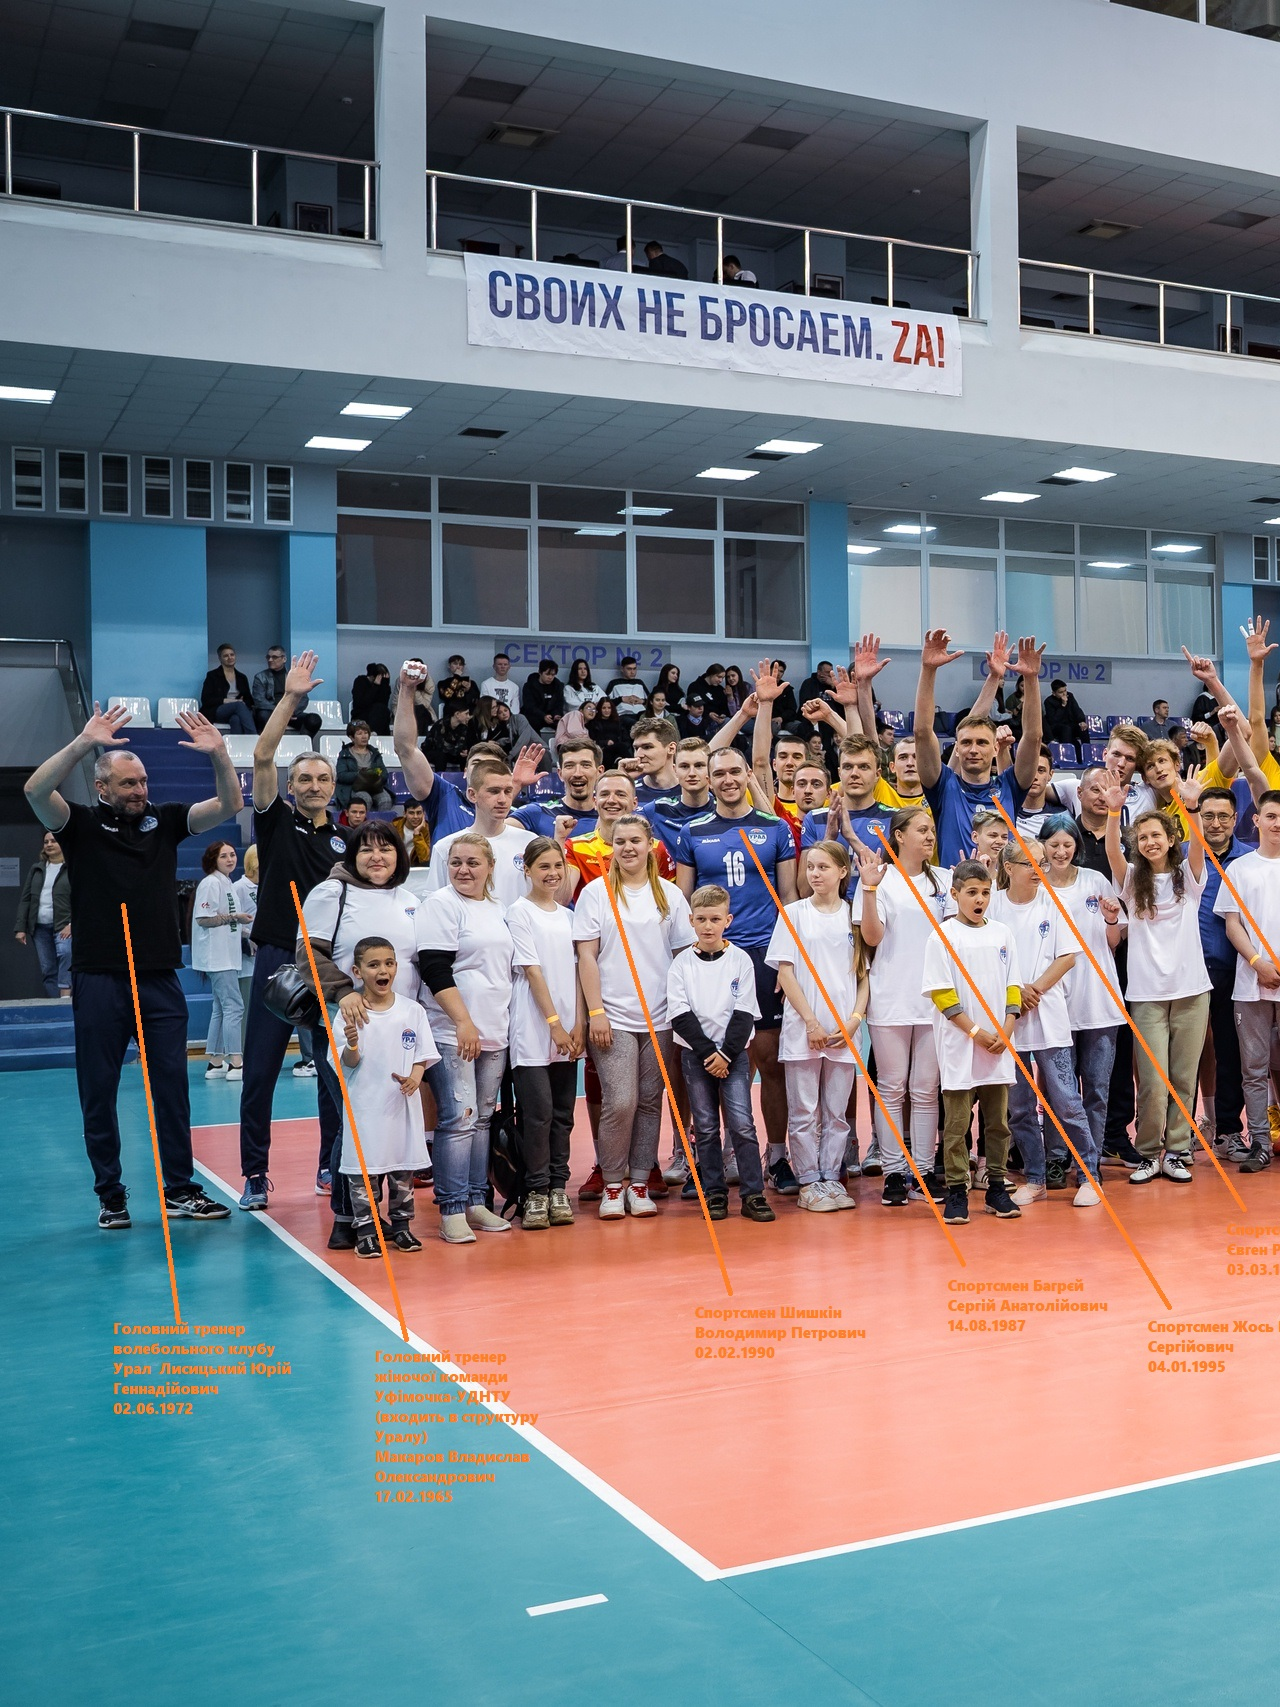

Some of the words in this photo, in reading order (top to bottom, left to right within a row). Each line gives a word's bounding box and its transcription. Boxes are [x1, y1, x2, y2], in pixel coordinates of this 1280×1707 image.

[488, 270, 625, 330] СВОИХ
[638, 287, 687, 338] НЕ
[699, 295, 883, 361] БРОСАЕМ.
[890, 320, 946, 369] ZA!
[504, 643, 607, 665] СЕКТОР
[650, 648, 663, 667] 2
[1068, 662, 1089, 680] №
[1095, 664, 1105, 681] 2
[723, 851, 745, 887] 16
